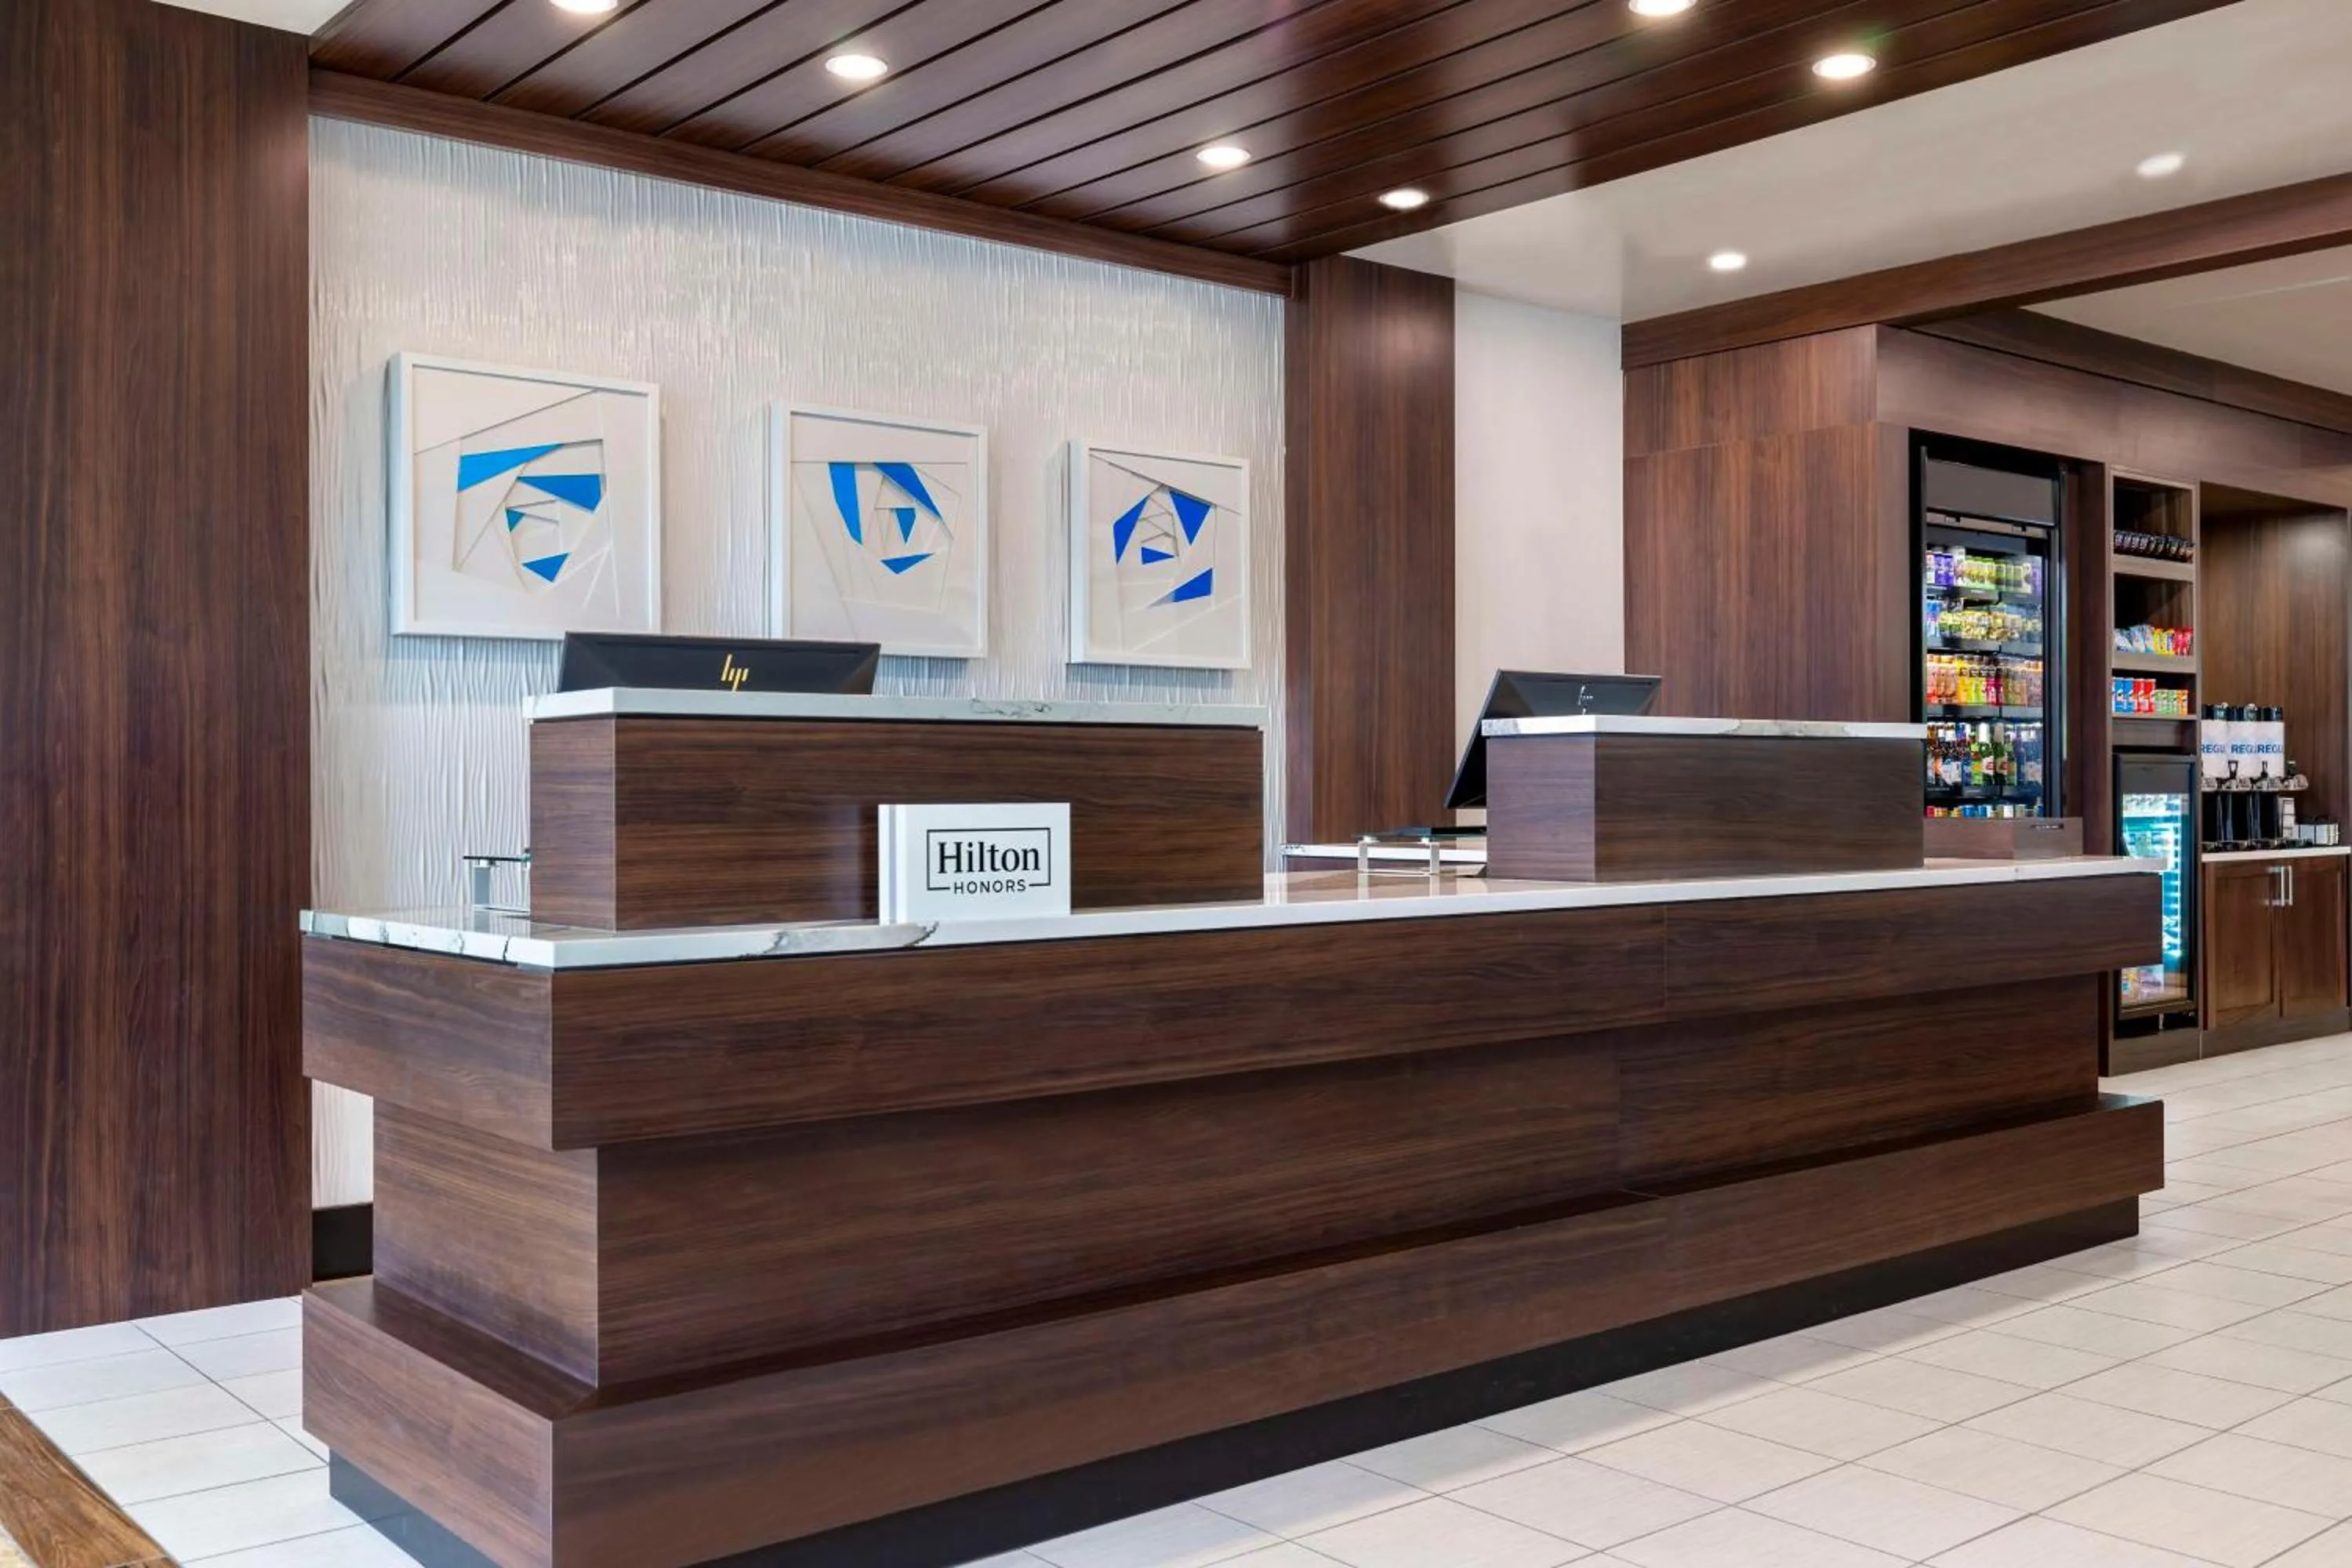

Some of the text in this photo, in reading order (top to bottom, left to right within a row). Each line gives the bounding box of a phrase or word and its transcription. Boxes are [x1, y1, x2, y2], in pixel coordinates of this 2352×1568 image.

[720, 653, 750, 694] hp
[938, 841, 1041, 874] Hilton
[953, 879, 1026, 894] HONORS
